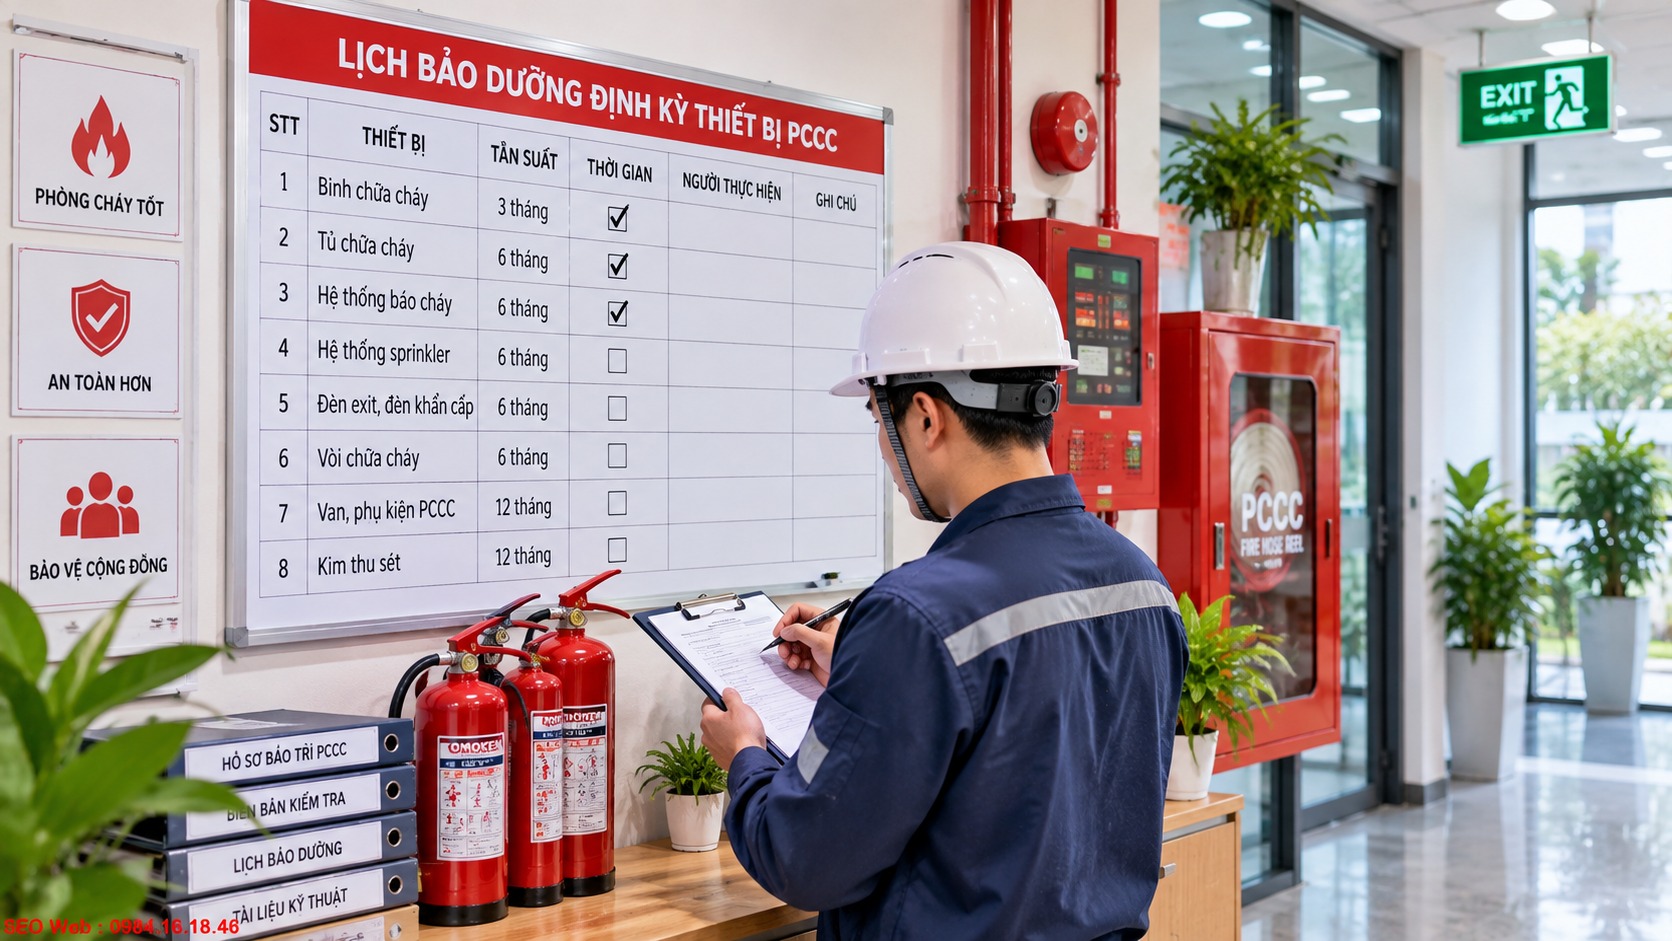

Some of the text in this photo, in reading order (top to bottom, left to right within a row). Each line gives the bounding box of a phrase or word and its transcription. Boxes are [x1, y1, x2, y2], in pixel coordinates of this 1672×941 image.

[338, 37, 838, 153] LỊCH BẢO DƯỠNG ĐỊNH KỲ THIẾT BỊ PCCC
[1480, 80, 1538, 109] EXIT
[269, 113, 300, 135] STT
[362, 124, 426, 157] THIẾT BỊ
[523, 147, 558, 170] SUẤT
[587, 157, 653, 183] THỜI GIAN
[280, 171, 288, 192] 1
[682, 171, 782, 204] NGƯỜI THỰC HIỆN
[35, 186, 90, 210] PHÒNG
[94, 192, 134, 214] CHÁY
[355, 180, 391, 204] chữa
[395, 185, 429, 212] cháy
[815, 192, 857, 212] GHI CHÚ
[498, 197, 549, 225] 3 tháng
[279, 227, 289, 247] 2
[318, 230, 415, 263] Tủ chữa cháy
[498, 247, 549, 274] 6 tháng
[279, 282, 289, 302] 3
[318, 285, 453, 317] Hệ thống báo cháy
[498, 297, 549, 324] 6 tháng
[278, 338, 289, 358] 4
[318, 338, 451, 367] Hệ thống sprinkler
[498, 347, 549, 372] 6 tháng
[48, 371, 152, 392] AN TOÀN HƠN
[278, 392, 289, 413] 5
[317, 392, 474, 420] Đèn exit, đèn khẩn cấp
[498, 397, 549, 422] 6 tháng
[278, 448, 289, 468] 6
[317, 447, 420, 472] Vòi chữa cháy
[498, 447, 549, 471] 6 tháng
[278, 503, 288, 523] 7
[317, 498, 456, 525] Van, phụ kiện PCCC
[495, 496, 552, 519] 12 tháng
[1241, 491, 1304, 532] PCCC
[86, 556, 125, 580] CỘNG
[278, 558, 289, 579] 8
[318, 552, 401, 576] Kim thu sét
[495, 545, 552, 568] 12 tháng
[245, 751, 262, 768] SƠ
[317, 742, 347, 760] PCCC
[322, 791, 346, 808] TRA
[234, 853, 264, 876] LỊCH
[232, 904, 253, 925] TÀI
[257, 900, 285, 922] LIỆU
